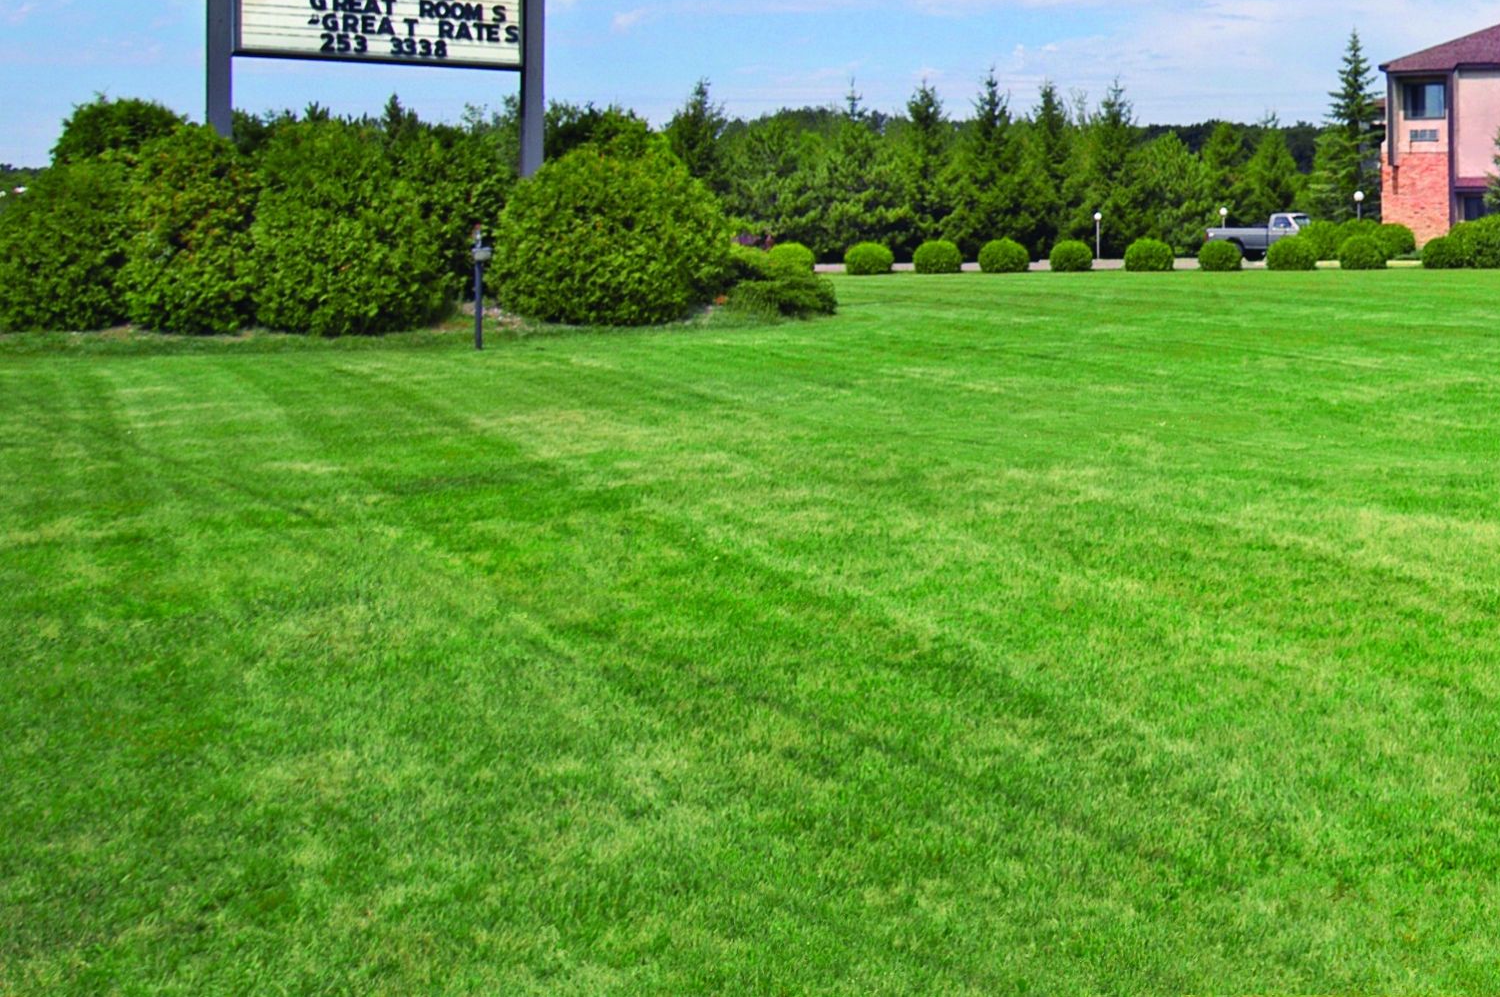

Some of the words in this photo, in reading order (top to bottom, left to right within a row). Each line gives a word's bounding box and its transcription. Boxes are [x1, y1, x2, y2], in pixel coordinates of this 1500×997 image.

[438, 18, 519, 44] RATES
[319, 32, 368, 53] 253
[390, 36, 447, 58] 3338
